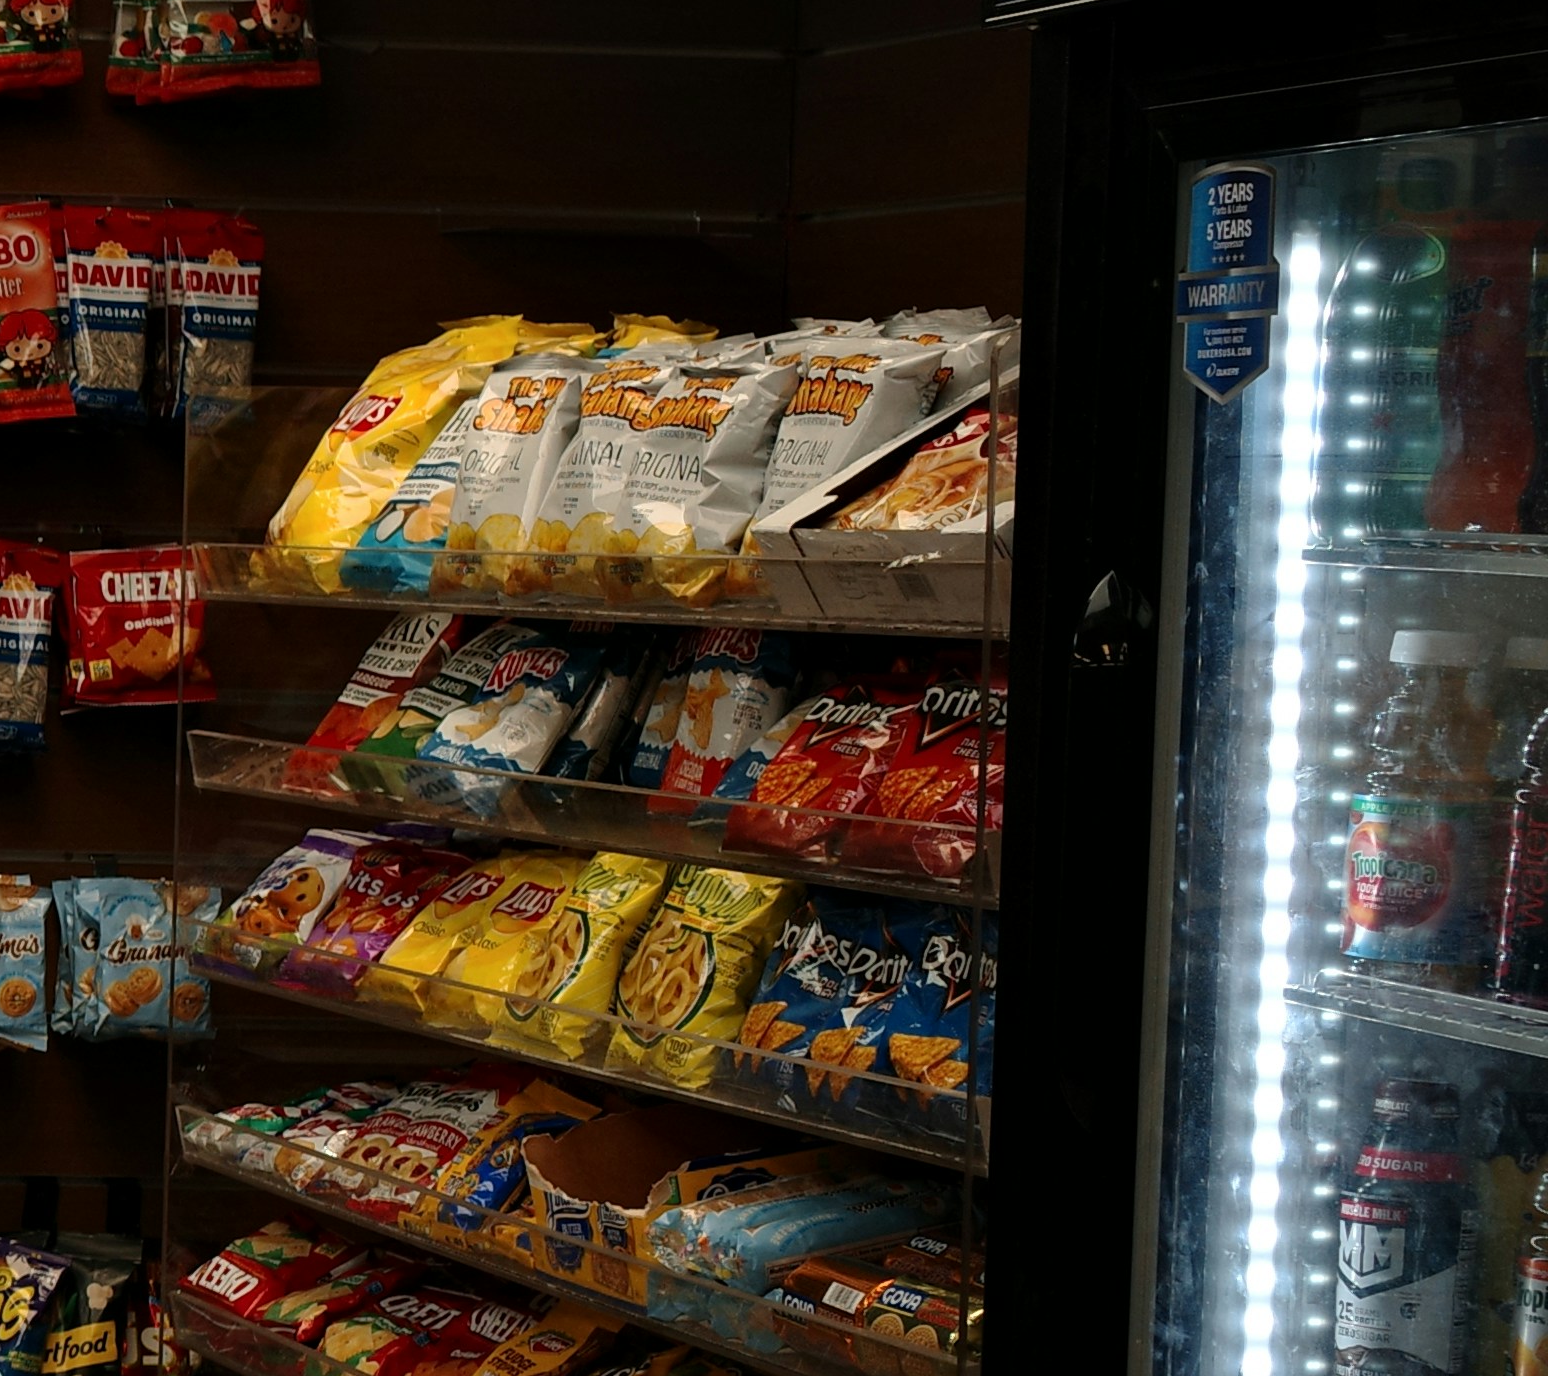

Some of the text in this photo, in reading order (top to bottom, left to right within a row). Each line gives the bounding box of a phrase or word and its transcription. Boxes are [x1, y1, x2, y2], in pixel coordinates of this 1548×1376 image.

[1208, 183, 1254, 206] 2 YEARS
[1207, 219, 1252, 241] 5 YEARS
[72, 265, 151, 288] DAVID
[1188, 281, 1265, 308] WARRANTY
[77, 305, 148, 319] ORIGINAL
[489, 649, 566, 693] RUFFLES
[1351, 850, 1437, 884] Tropicana
[504, 881, 560, 918] Lay's
[910, 1232, 948, 1256] GOYA
[880, 1285, 926, 1310] GOYA
